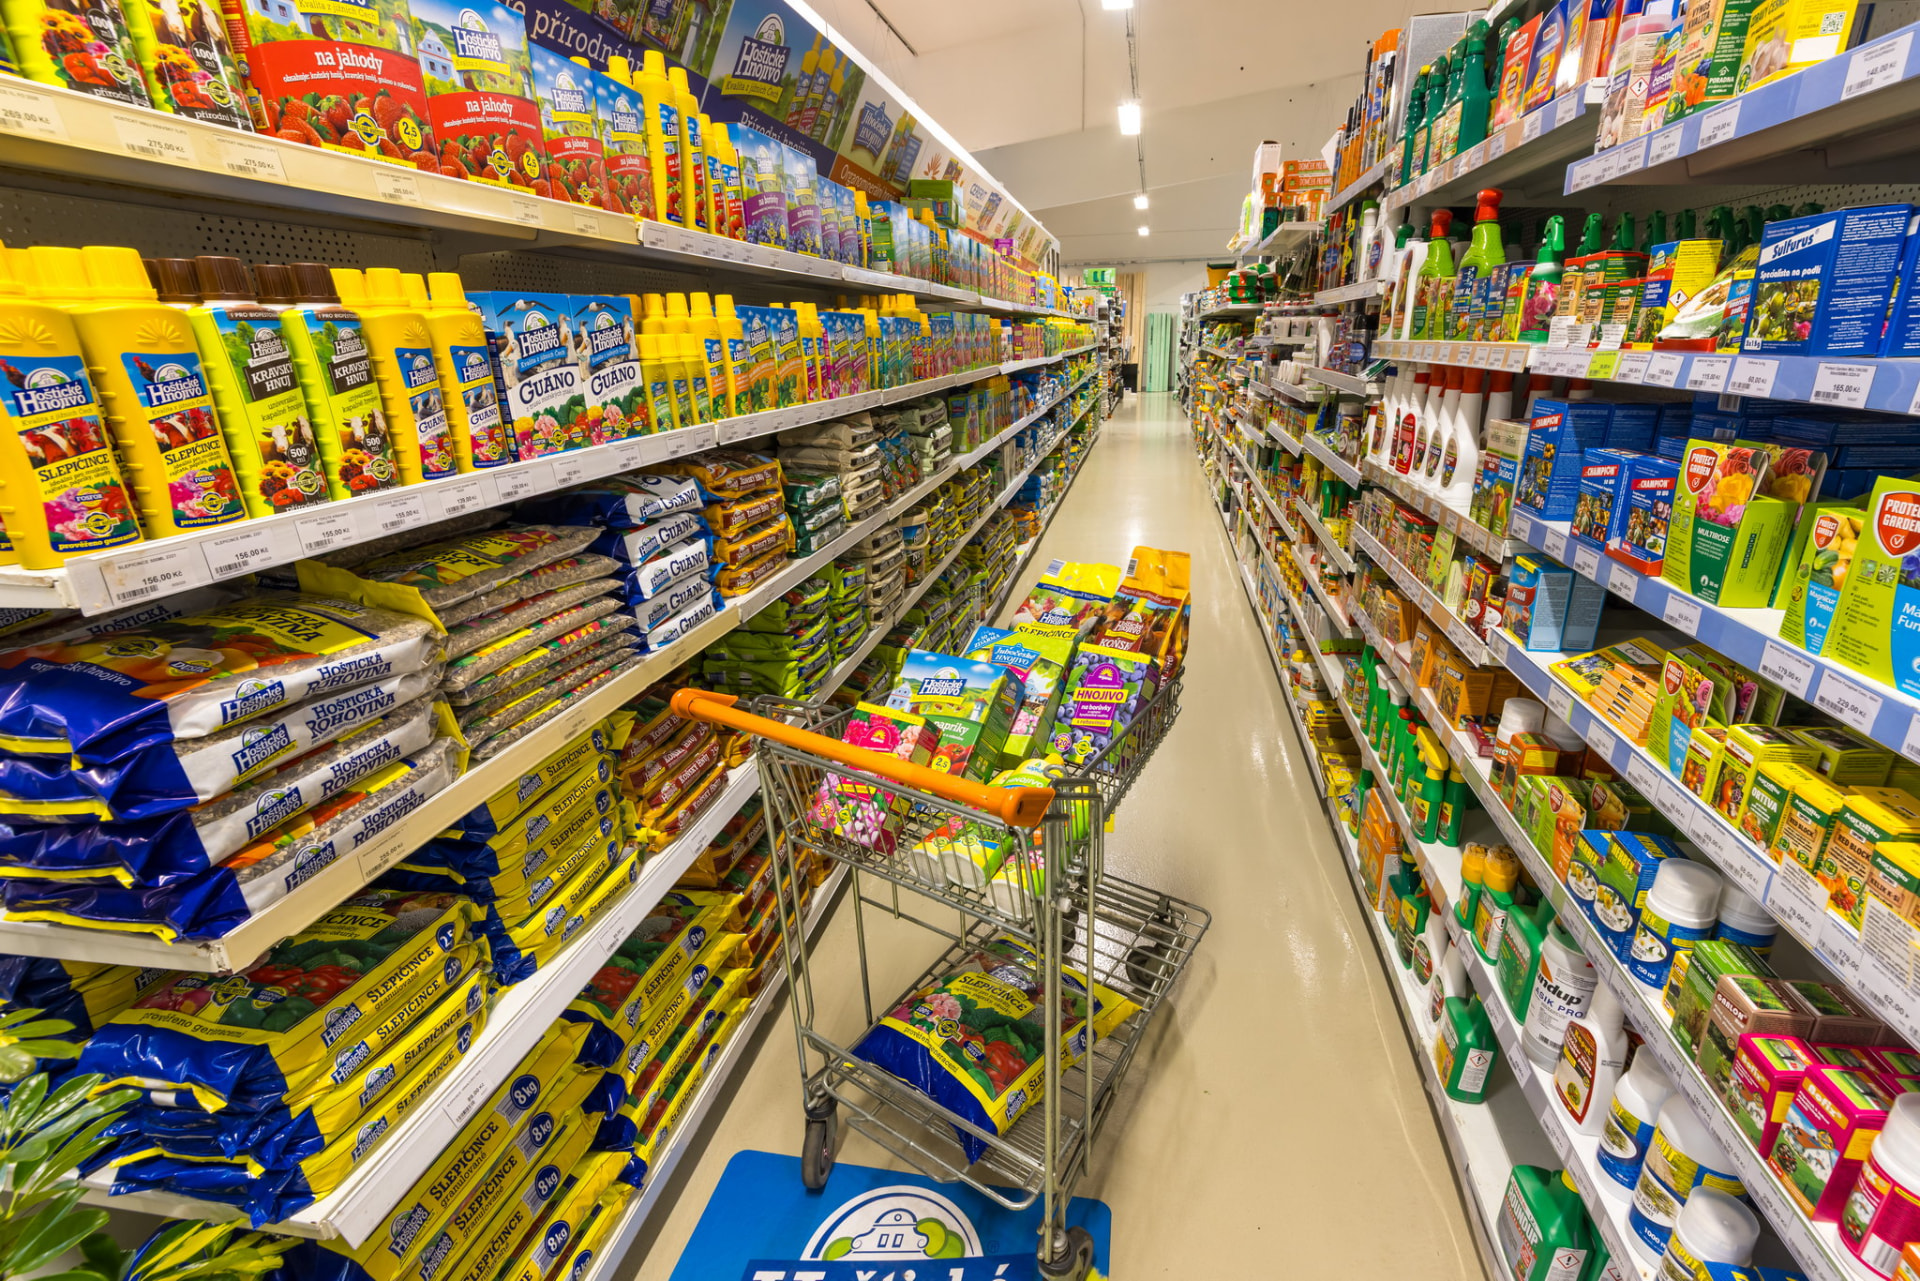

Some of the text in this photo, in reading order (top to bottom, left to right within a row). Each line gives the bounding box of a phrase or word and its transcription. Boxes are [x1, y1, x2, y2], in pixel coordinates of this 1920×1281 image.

[314, 48, 384, 75] na jahody
[465, 98, 514, 118] na jahody
[1771, 231, 1815, 260] Sulfurus
[1759, 264, 1822, 280] Specialista na padlí
[519, 366, 576, 405] GUÁNO
[164, 439, 221, 465] SLEPIČINCE
[1690, 451, 1715, 467] PROTECT
[37, 452, 110, 484] SLEPIČINCE
[1585, 465, 1617, 477] CHAMPION
[1688, 463, 1712, 477] GARDEN
[1639, 478, 1669, 490] CHAMPION
[662, 488, 698, 511] GUÁNO
[1697, 526, 1731, 545] MULTIROSE
[1818, 518, 1837, 531] PROTECT
[669, 551, 705, 578] GUÁNO
[141, 570, 173, 586] 156,00
[1809, 589, 1836, 606] Magnicur
[1816, 601, 1835, 613] Finito
[1017, 625, 1076, 640] SLEPIČINCE
[87, 660, 132, 687] hnojivo
[317, 652, 384, 681] HOŠTICKÁ
[311, 684, 385, 721] HOŠTICKÁ
[1075, 689, 1125, 702] HNOJIVO
[1089, 704, 1112, 713] borůvky
[1836, 697, 1859, 715] 229,00
[305, 692, 396, 740] ROHOVINA
[933, 719, 970, 737] papriky
[330, 738, 392, 778] HOŠTICKÁ
[321, 746, 402, 798] ROHOVINA
[361, 788, 417, 831] HOŠTICKÁ
[1751, 786, 1778, 813] ORTIVA
[1798, 821, 1814, 839] BLOCK
[1611, 841, 1636, 876] HERBEX
[1838, 834, 1872, 861] RED BLOCK
[1557, 1004, 1584, 1019] PRO
[1715, 993, 1745, 1021] GARLON
[1741, 1053, 1766, 1083] Bofix
[513, 1079, 538, 1105] 8 kg
[1806, 1083, 1843, 1121] Bofix
[429, 1121, 499, 1201] SLEPIČINCE
[440, 1151, 488, 1210] granulované
[454, 1154, 518, 1232] SLEPIČINCE
[536, 1169, 560, 1194] 8 kg
[1508, 1186, 1539, 1245] ROUNDUP
[547, 1227, 568, 1251] 8 kg
[1643, 1226, 1661, 1244] 1000
